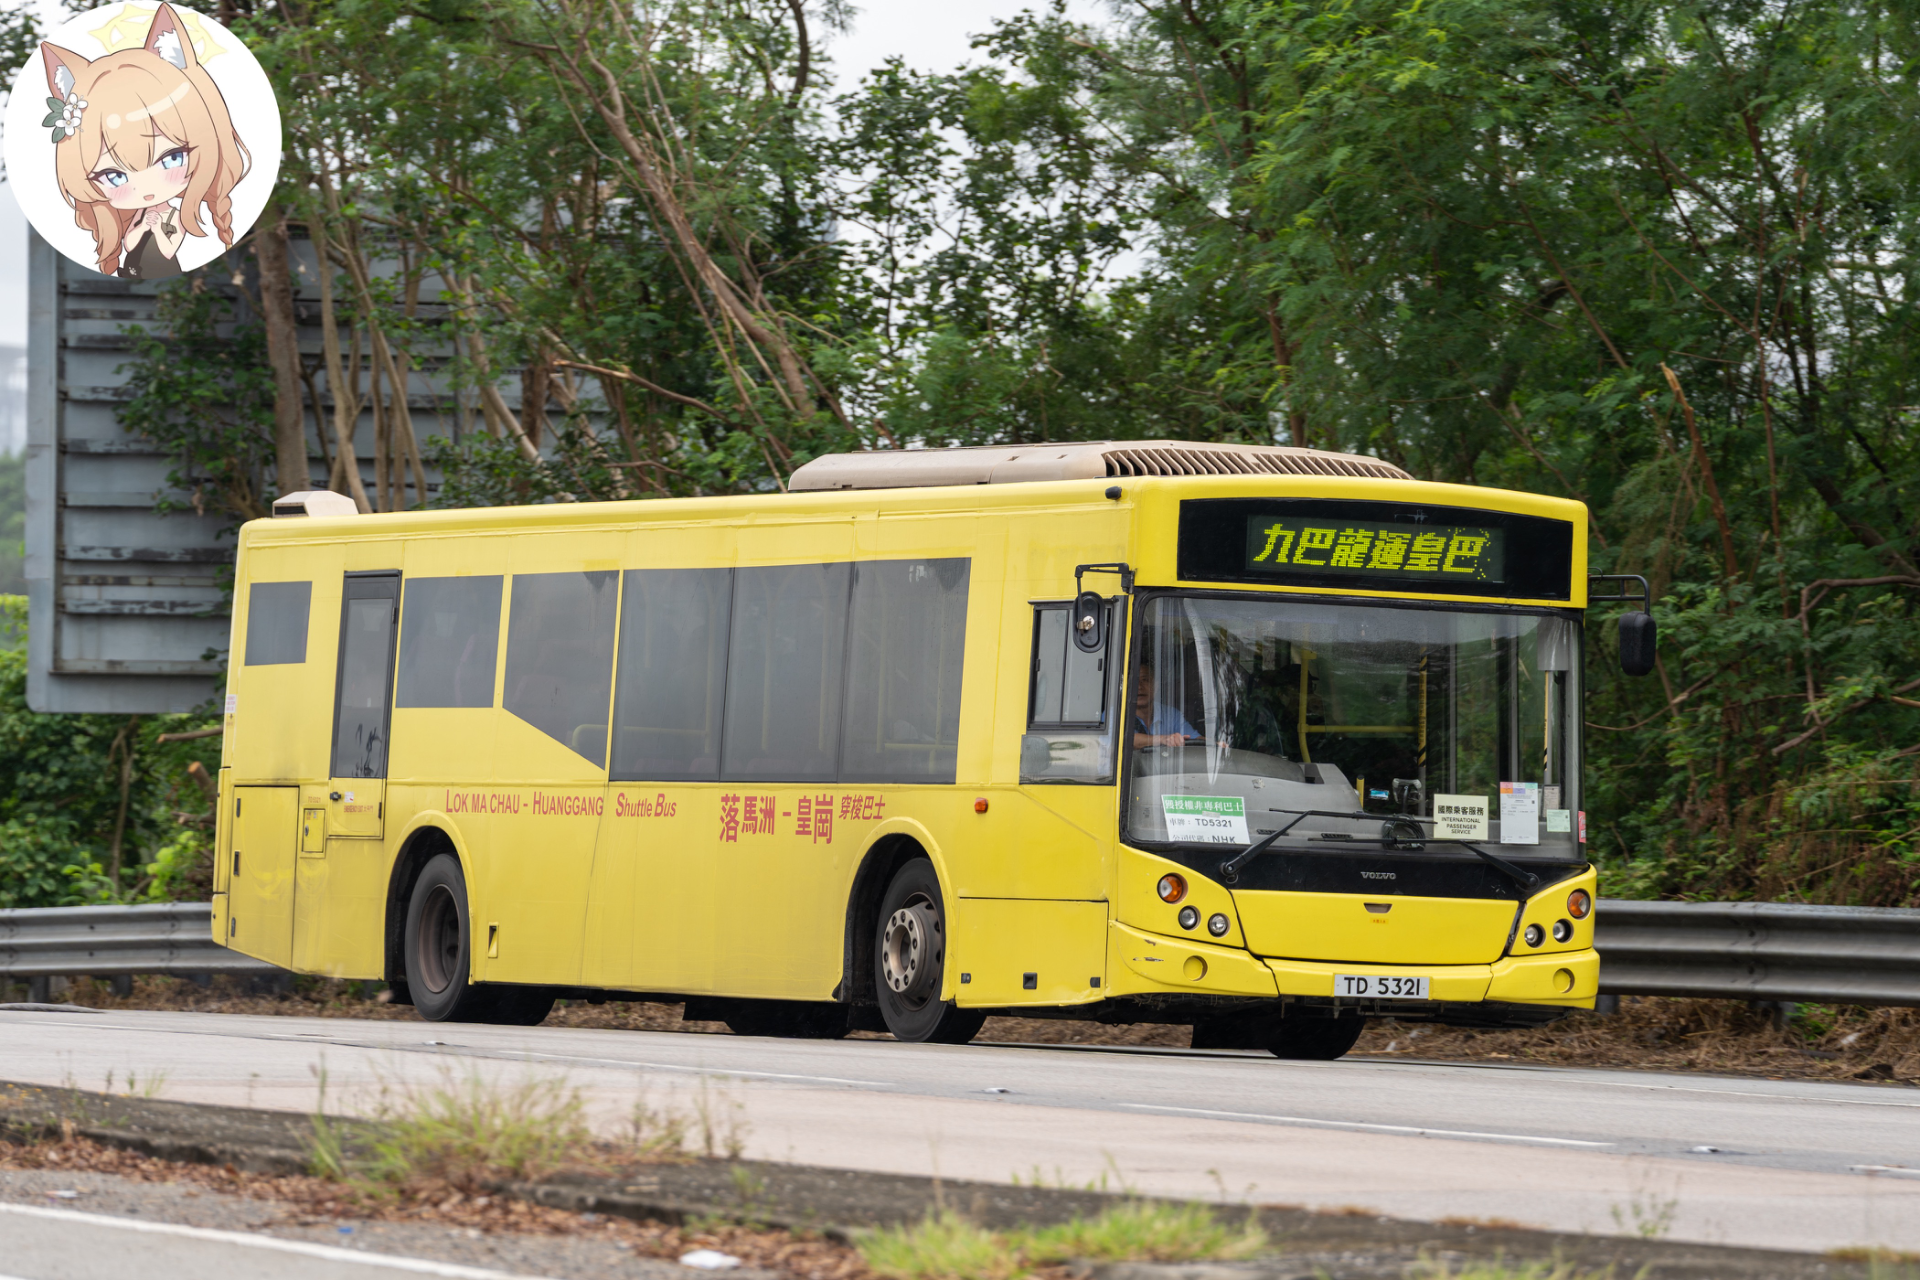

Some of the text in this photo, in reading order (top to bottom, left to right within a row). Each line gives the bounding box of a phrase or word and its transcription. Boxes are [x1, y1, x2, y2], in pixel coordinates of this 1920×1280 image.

[1253, 523, 1488, 573] 九巴龍運皇巴
[446, 789, 468, 813] LOK
[471, 793, 487, 813] MA
[489, 794, 520, 814] CHAU
[532, 791, 604, 816] HUANGGANG
[615, 792, 653, 817] Shuttle
[654, 793, 677, 818] Bus
[1437, 804, 1485, 817] 國際乘客服務
[719, 793, 776, 843] 落馬洲
[795, 793, 834, 845] 皇崗
[838, 794, 886, 821] 穿梭巴士
[1195, 818, 1233, 828] TD5321
[1441, 816, 1481, 824] INTERNATIONAL
[1212, 835, 1236, 843] NHK
[1360, 871, 1397, 880] VOLVO
[1344, 976, 1421, 996] TD 5321
